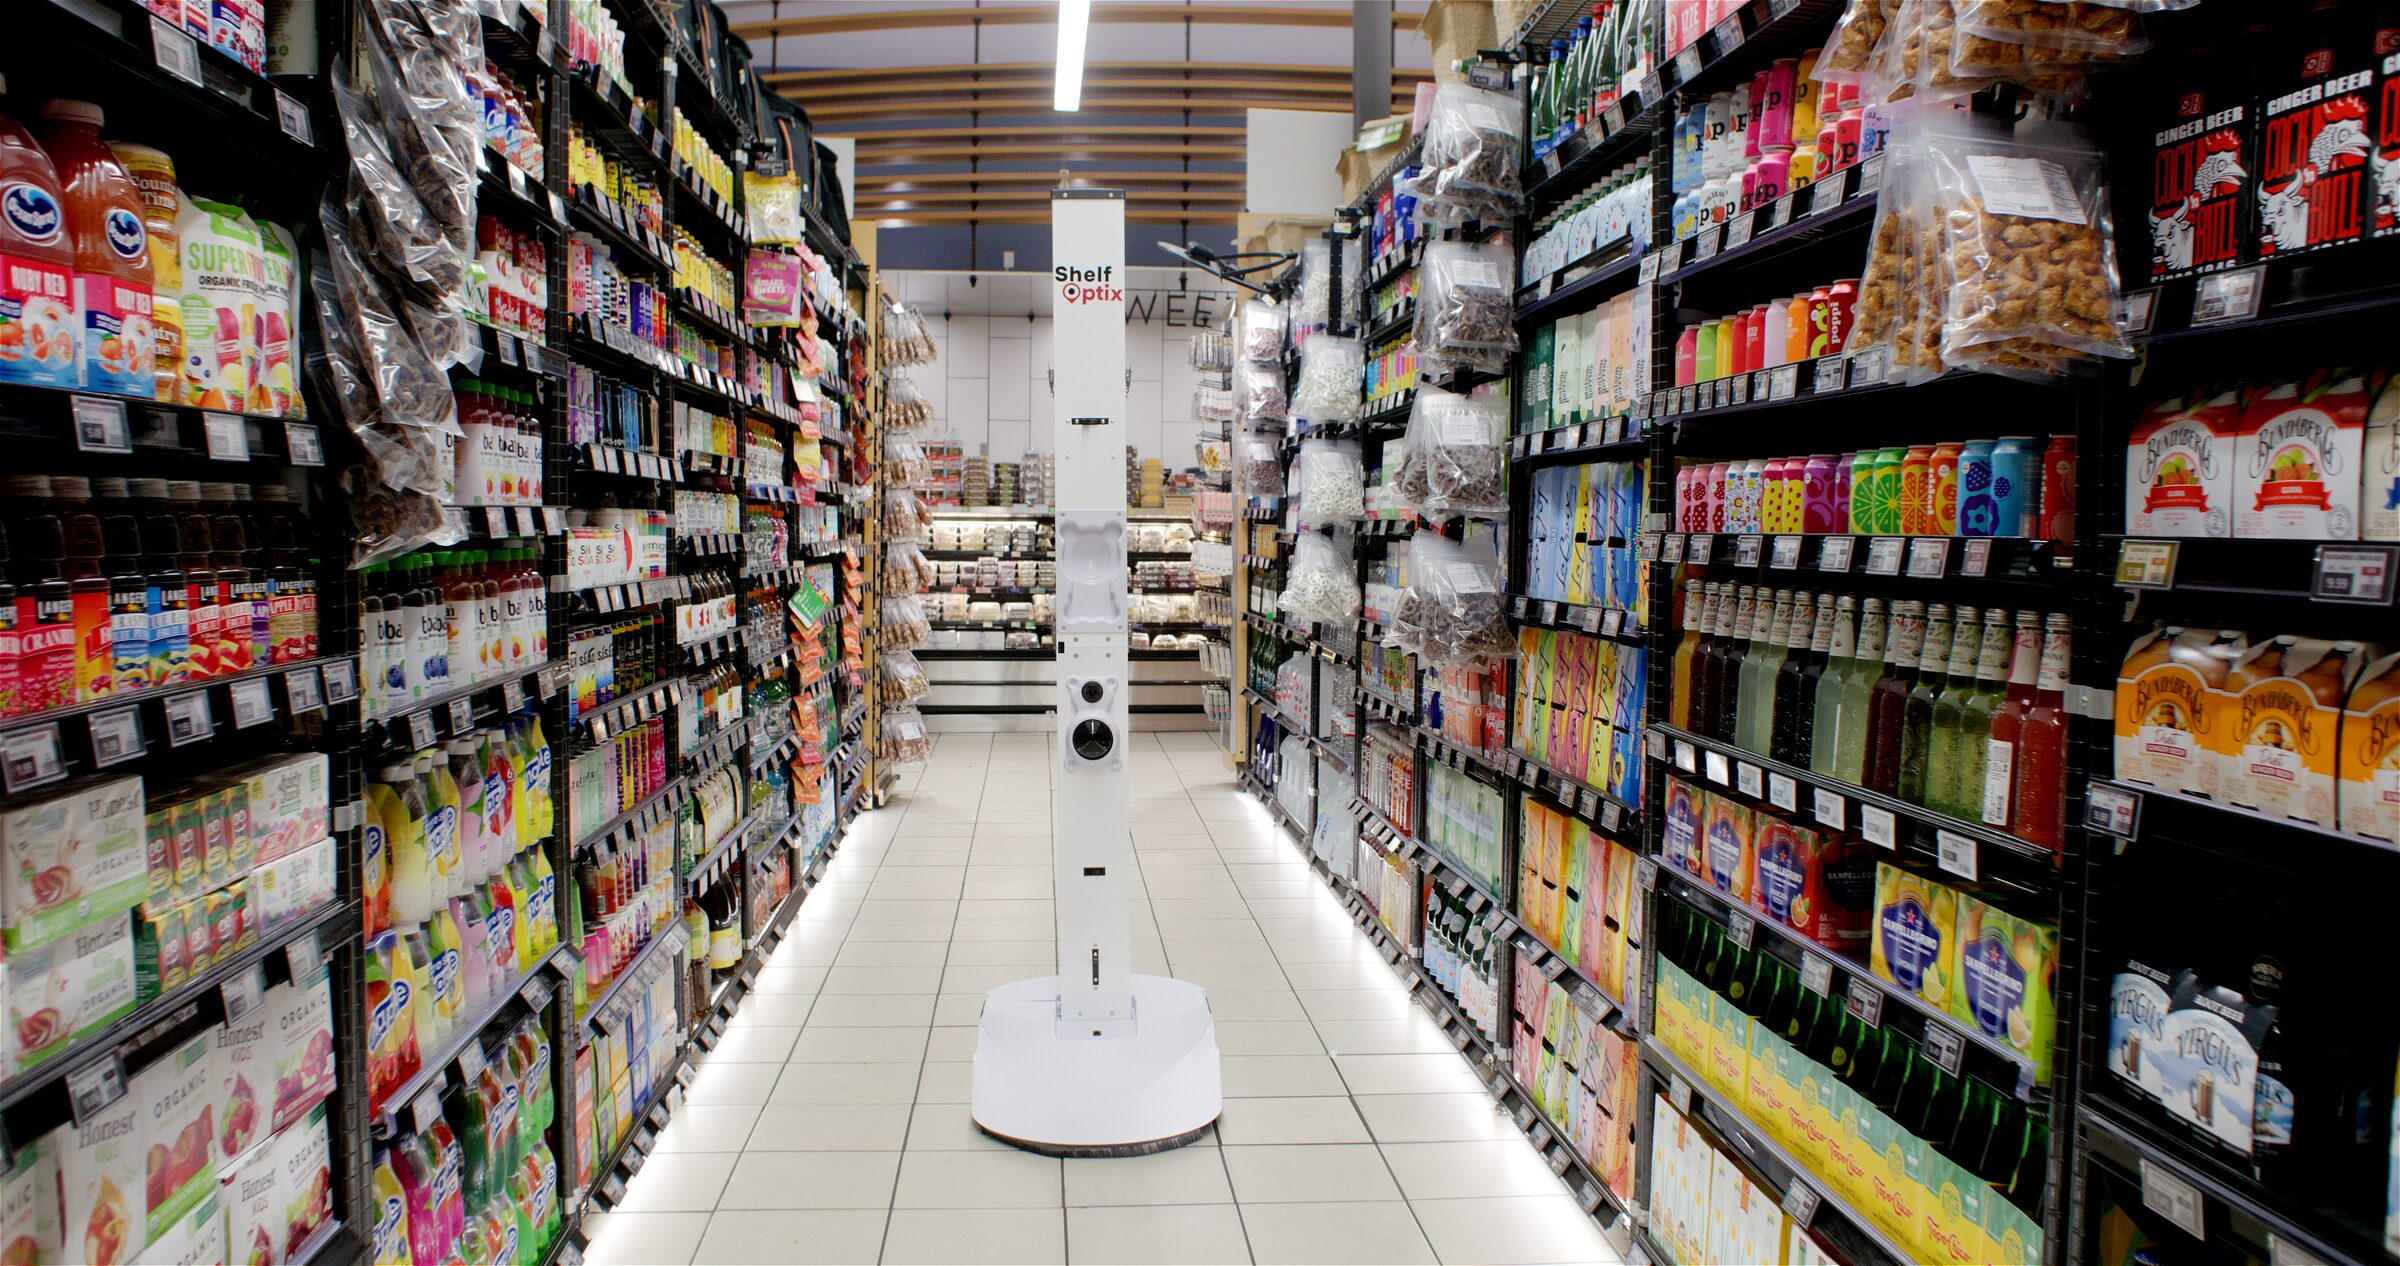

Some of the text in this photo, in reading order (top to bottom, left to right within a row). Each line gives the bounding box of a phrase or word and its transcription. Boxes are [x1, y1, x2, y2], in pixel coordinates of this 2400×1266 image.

[2267, 70, 2373, 116] GINGER BEER
[2156, 106, 2243, 146] GINGER BEER
[2264, 109, 2311, 181] COCK
[2155, 140, 2196, 206] COCK
[2194, 200, 2238, 264] BULL
[2308, 171, 2361, 246] BULL
[198, 275, 240, 289] ORGANIC
[1055, 265, 1112, 283] Shelf
[1063, 283, 1123, 305] Optix
[1830, 300, 1842, 345] poppi
[2139, 426, 2219, 483] BUNDABERG
[2249, 415, 2344, 479] BUNDABERG
[2129, 674, 2212, 736] BUNDABERG
[2233, 689, 2321, 757] BUNDABERG
[2153, 728, 2185, 746] Diet
[2259, 748, 2290, 768] Diet
[216, 1019, 266, 1049] Honest
[281, 991, 327, 1030] ORGANIC
[2112, 988, 2166, 1042] VIRGIL'S
[2175, 1026, 2243, 1087] VIRGIL'S
[153, 1067, 207, 1119] ORGANIC
[79, 1109, 137, 1150] Honest
